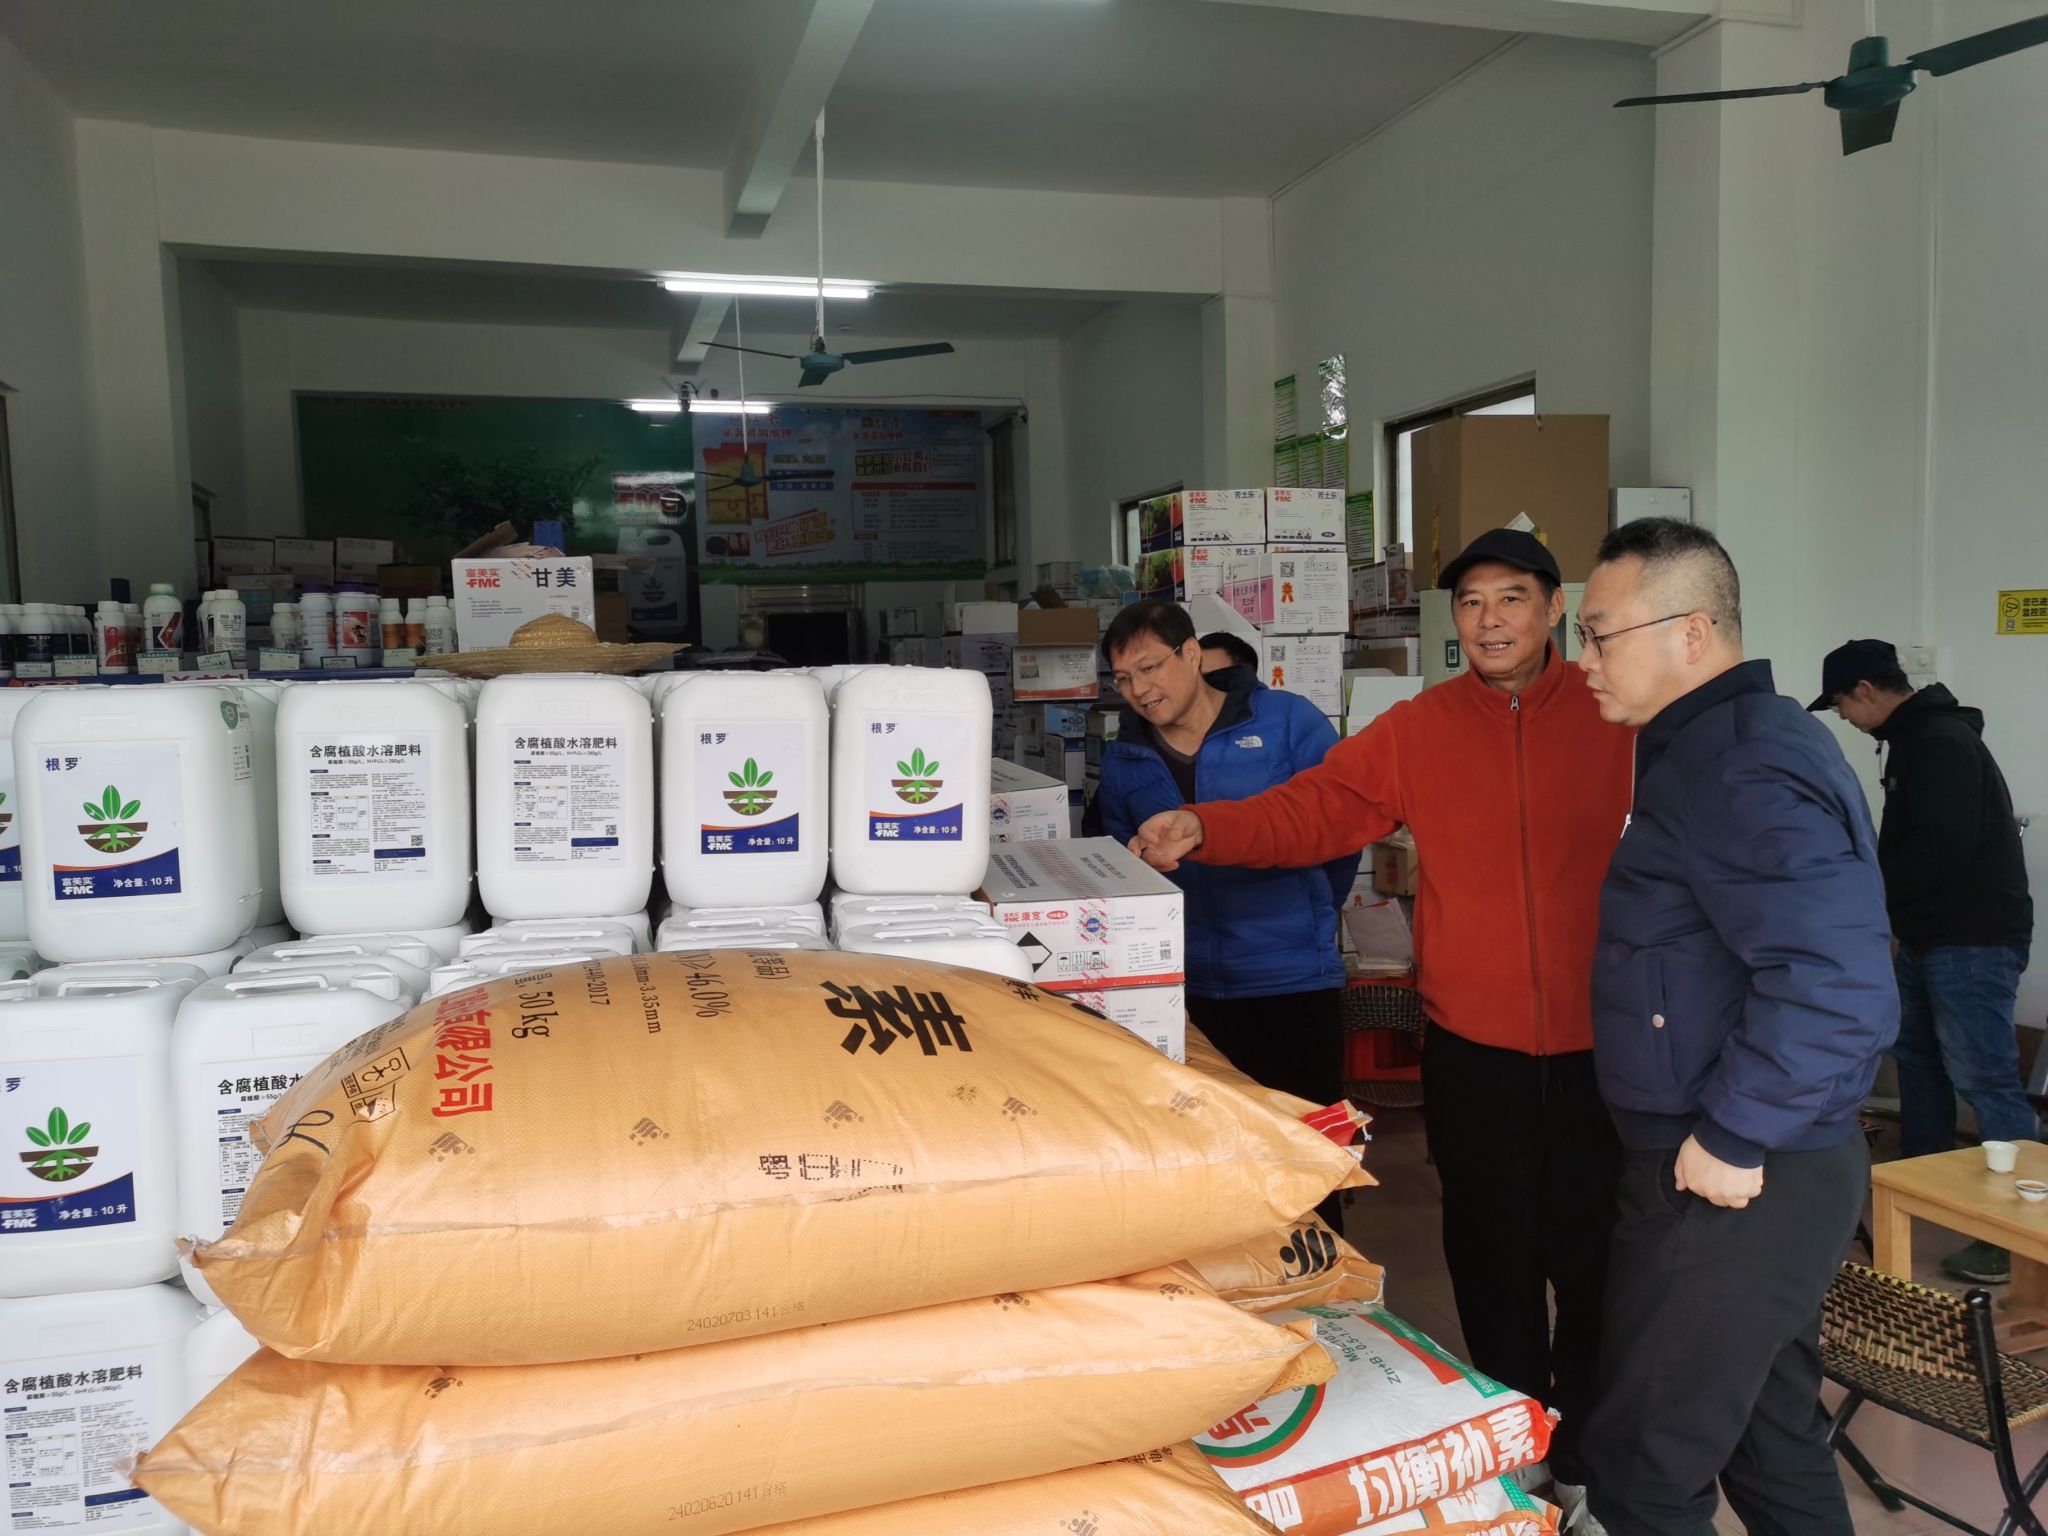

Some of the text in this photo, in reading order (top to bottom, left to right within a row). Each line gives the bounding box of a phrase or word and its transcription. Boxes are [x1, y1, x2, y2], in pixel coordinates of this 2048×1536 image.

[466, 578, 501, 588] FMC
[531, 566, 577, 588] 甘美
[514, 737, 618, 749] 含腐植酸水溶肥料
[700, 733, 727, 745] 根罗
[310, 744, 421, 758] 含腐植酸水溶肥料
[45, 757, 78, 772] 根罗
[874, 830, 899, 838] FMC
[62, 886, 94, 895] FMC
[1021, 911, 1042, 921] 康宽
[820, 980, 973, 1056] 素
[2, 1219, 38, 1230] FMC
[4, 1364, 143, 1395] 含腐植酸水溶肥料
